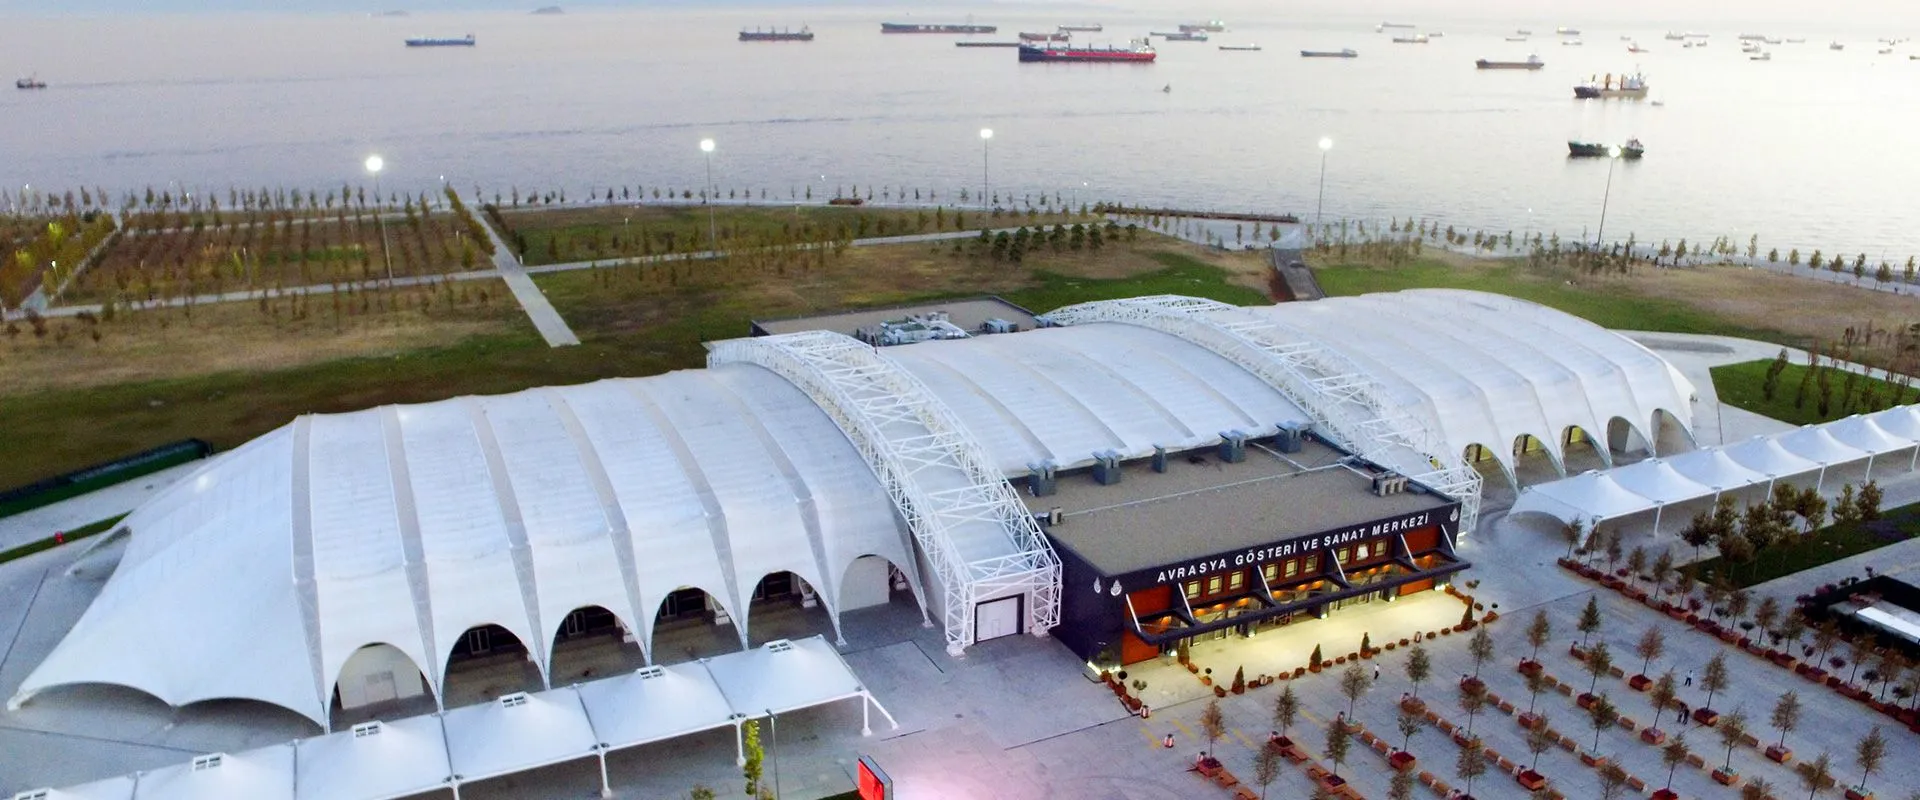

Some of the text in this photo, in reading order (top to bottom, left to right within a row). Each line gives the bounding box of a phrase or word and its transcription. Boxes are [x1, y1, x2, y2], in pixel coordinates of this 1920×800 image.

[1157, 512, 1430, 583] AVRASYA GÖSTERİ VE SANAT MERKEZİ
